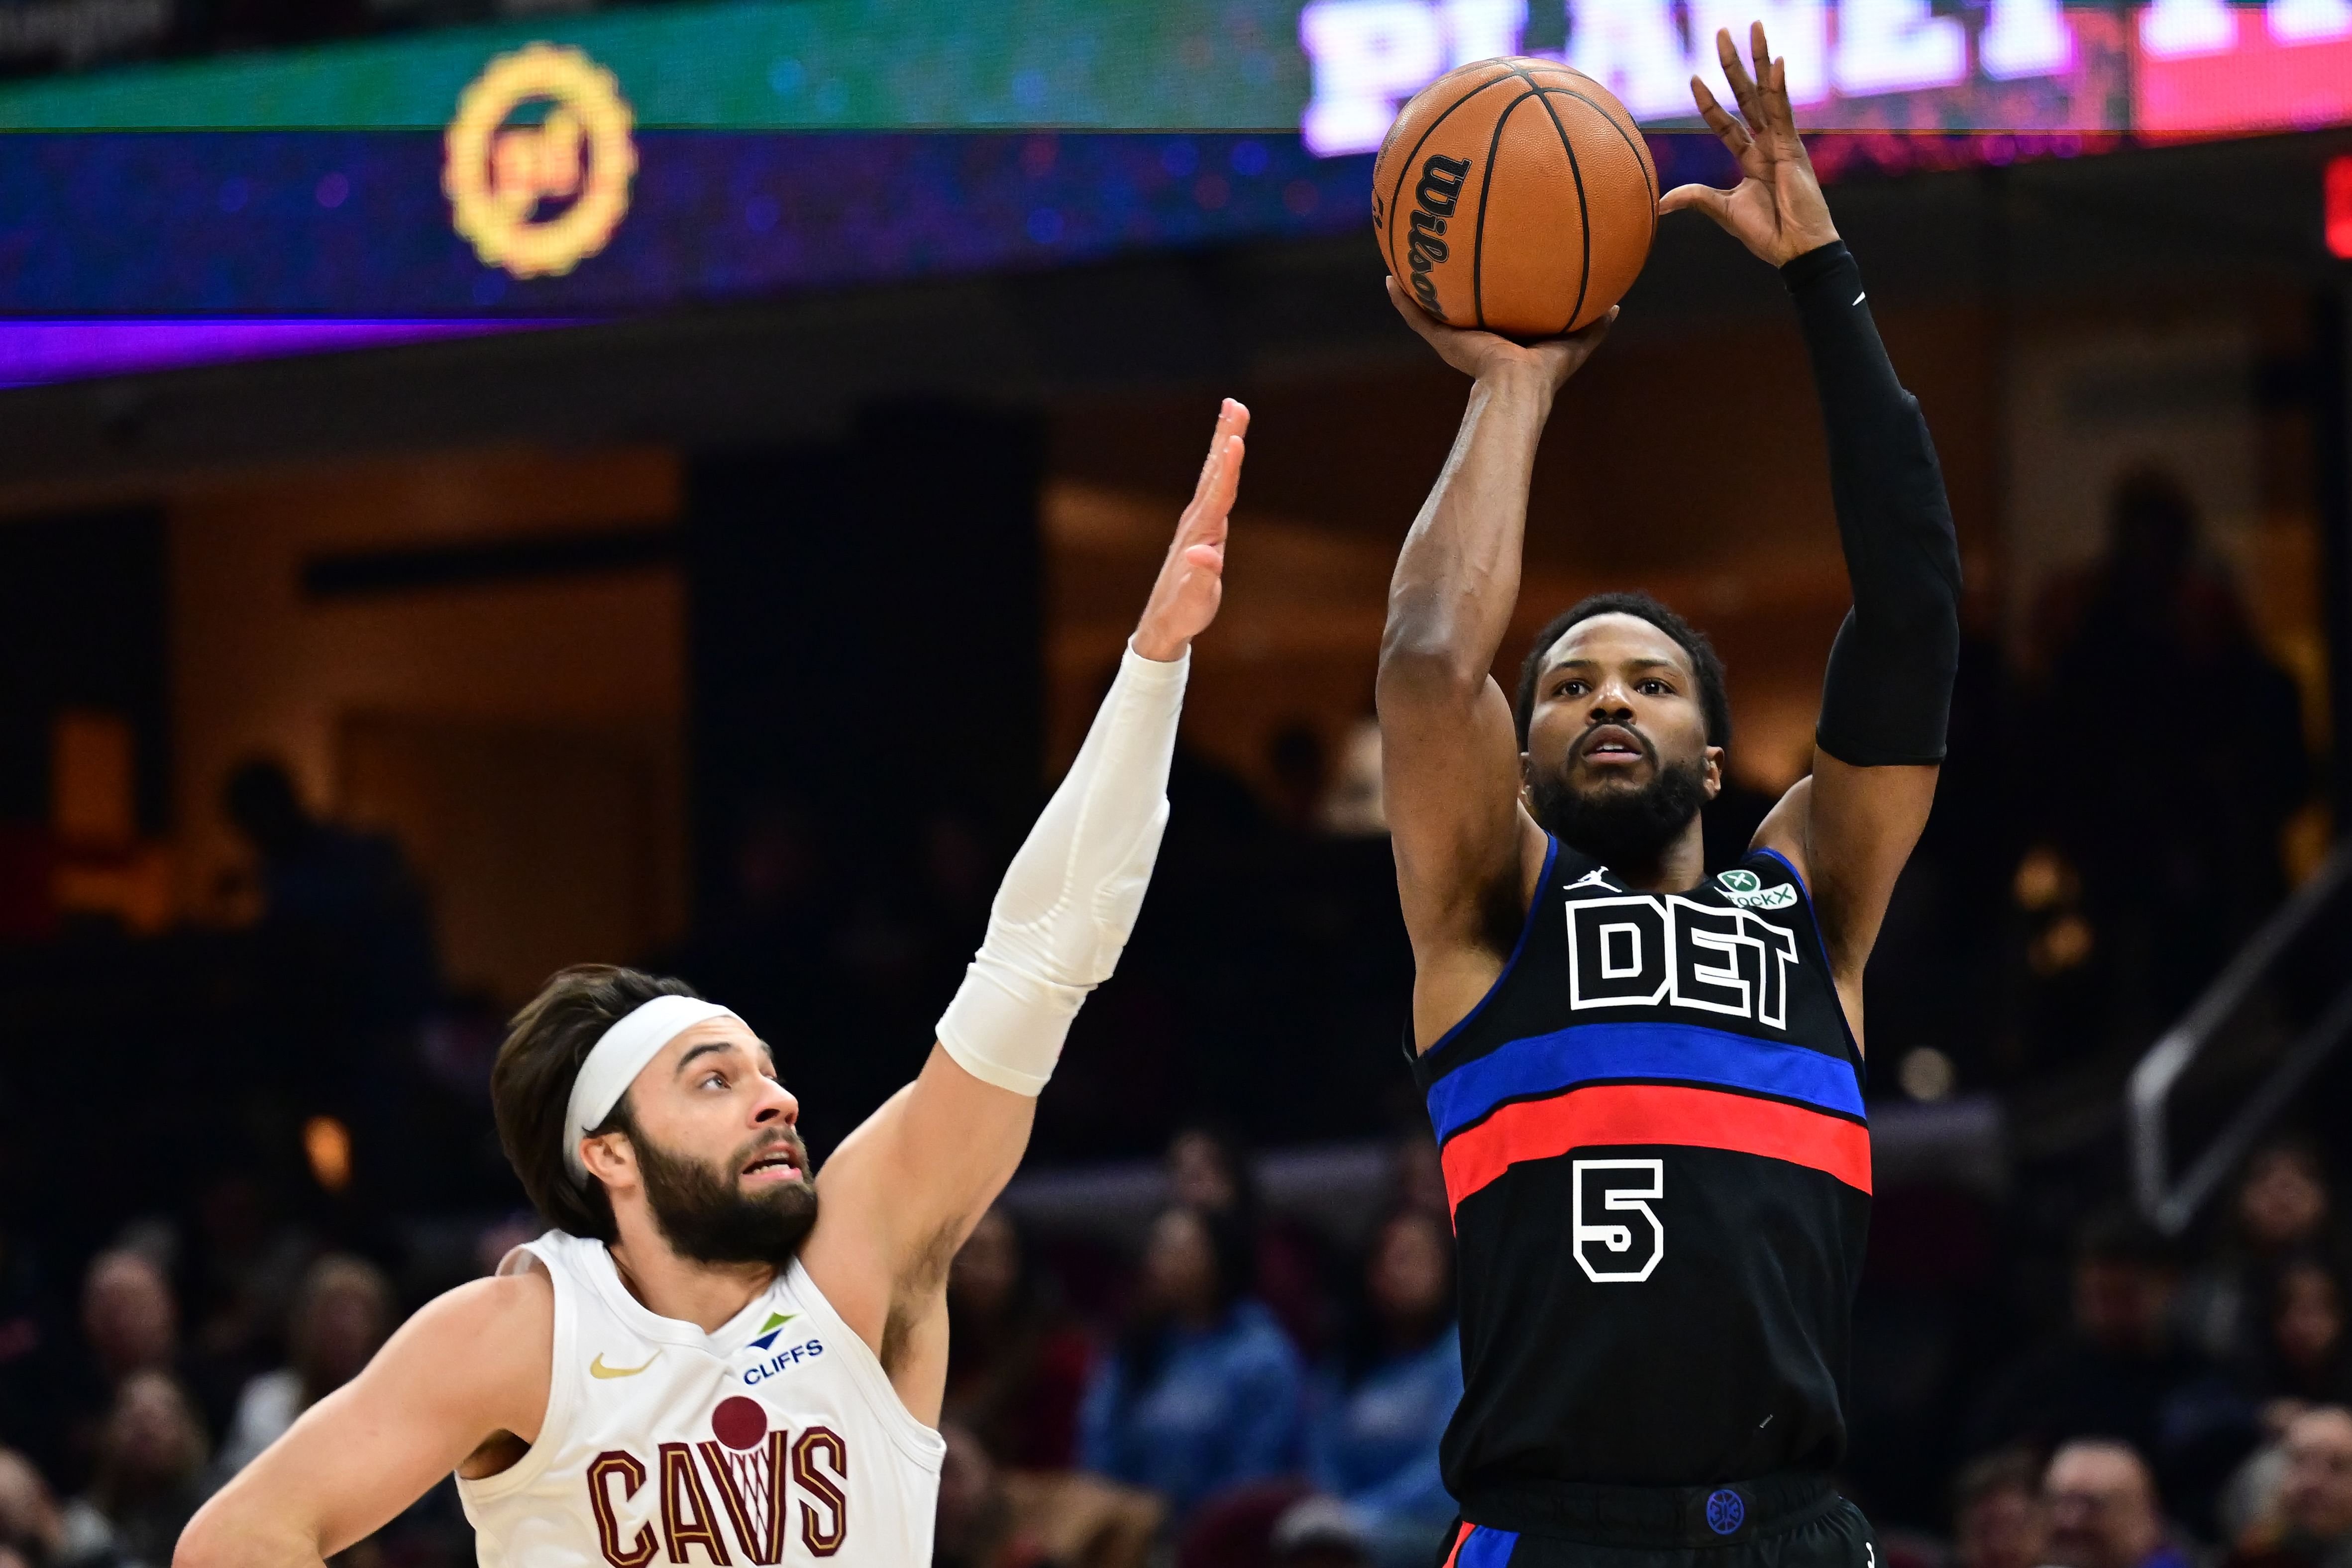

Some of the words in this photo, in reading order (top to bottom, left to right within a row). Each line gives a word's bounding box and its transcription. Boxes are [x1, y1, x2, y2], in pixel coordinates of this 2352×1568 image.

[1727, 886, 1793, 907] tockX
[1565, 895, 1799, 1030] DET
[1573, 1159, 1663, 1282] 5
[744, 1340, 823, 1384] CLIFFS
[587, 1426, 847, 1568] CAVS
